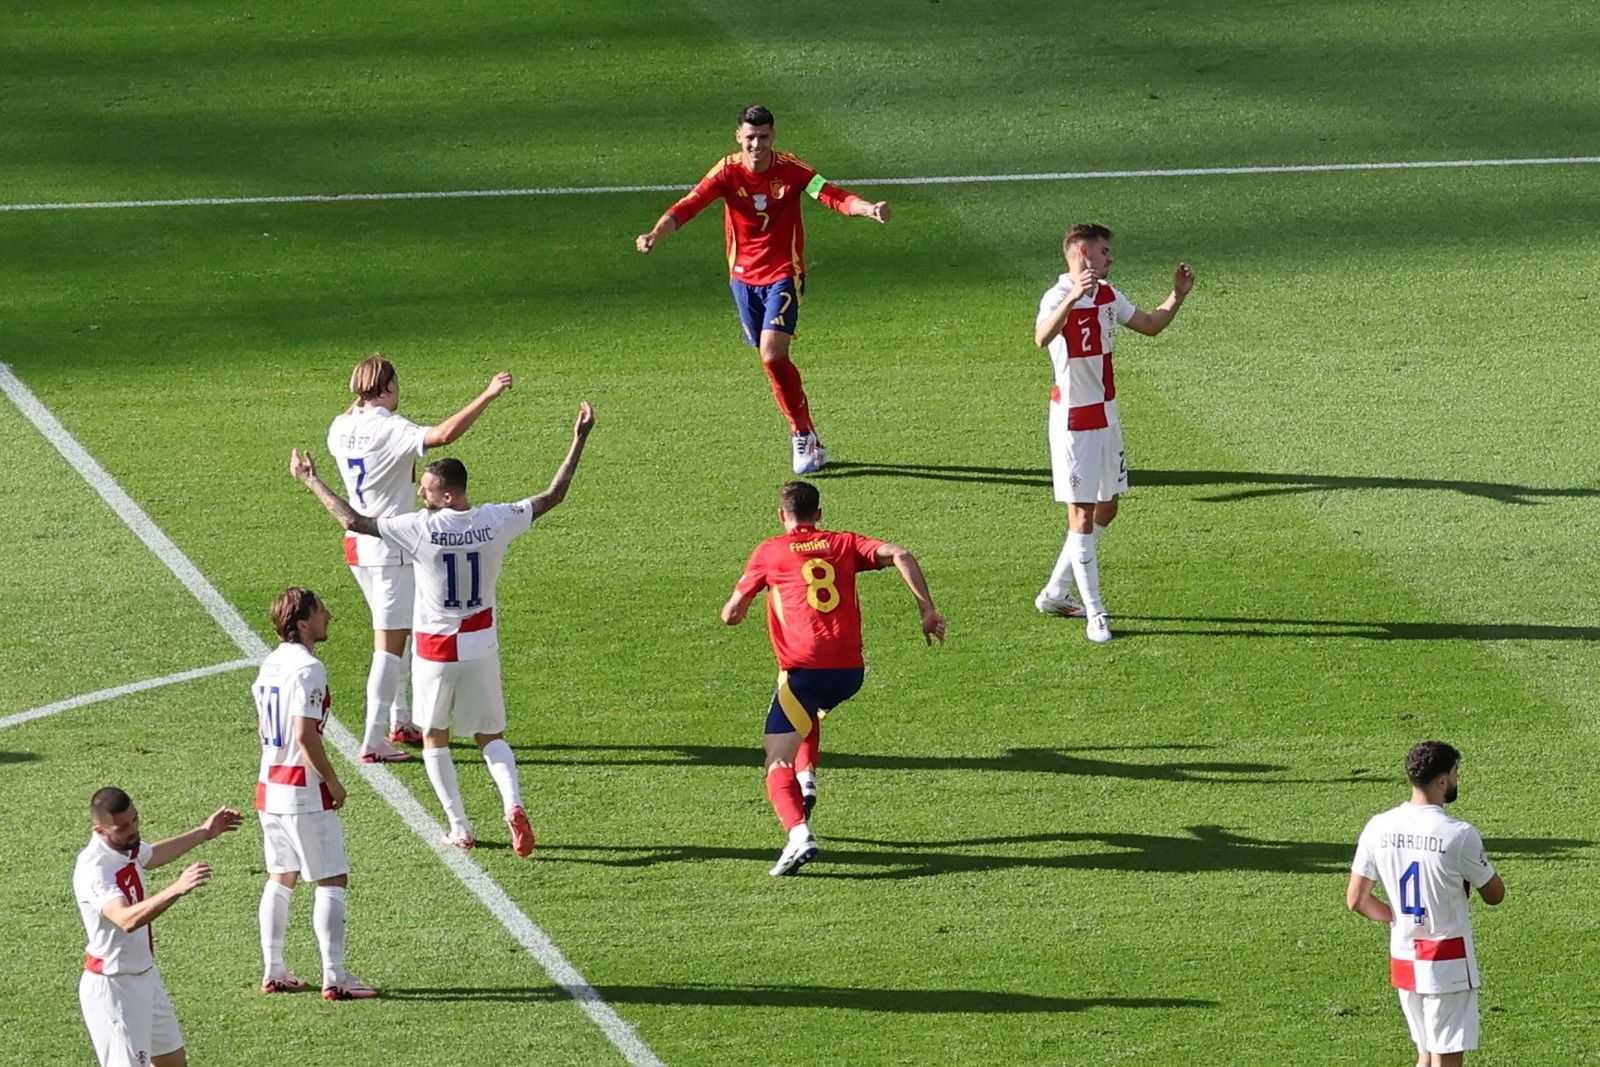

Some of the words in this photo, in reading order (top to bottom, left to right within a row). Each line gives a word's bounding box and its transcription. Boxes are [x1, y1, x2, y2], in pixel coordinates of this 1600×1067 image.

[756, 212, 769, 232] 7
[780, 291, 792, 314] 7
[1081, 327, 1092, 352] 2
[347, 458, 366, 509] 7
[442, 551, 482, 609] 11
[801, 557, 840, 614] 8
[1380, 833, 1446, 854] GVARDIOL
[1399, 860, 1427, 926] 4
